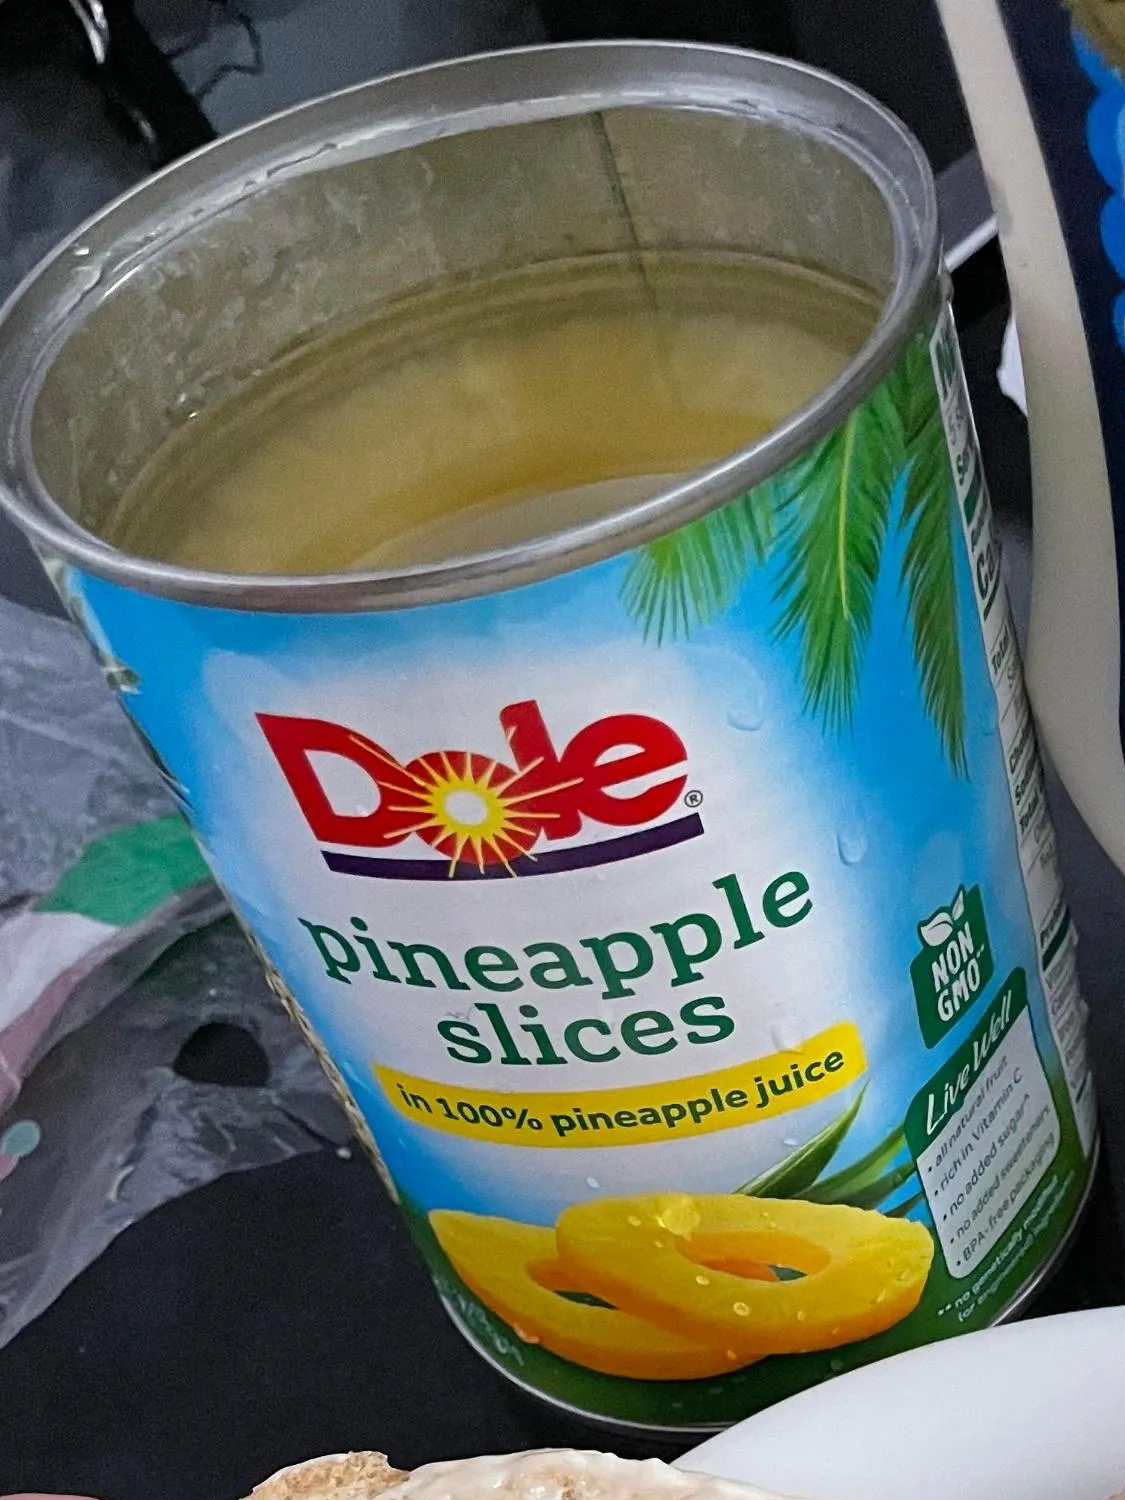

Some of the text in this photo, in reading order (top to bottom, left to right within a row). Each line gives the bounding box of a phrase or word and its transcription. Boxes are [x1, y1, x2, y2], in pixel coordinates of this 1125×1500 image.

[254, 699, 689, 866] Dole
[297, 870, 814, 1000] pineapple
[931, 921, 975, 994] NON
[437, 996, 736, 1068] slices
[926, 989, 1013, 1136] Live Well
[397, 1047, 845, 1137] in 100% pineapple juice
[935, 1143, 949, 1168] all
[950, 1088, 985, 1149] natural
[940, 1067, 1024, 1192] rich in Vitamin C
[949, 1193, 965, 1216] no
[965, 1142, 998, 1195] added
[956, 1220, 971, 1241] no
[970, 1174, 1001, 1223] added
